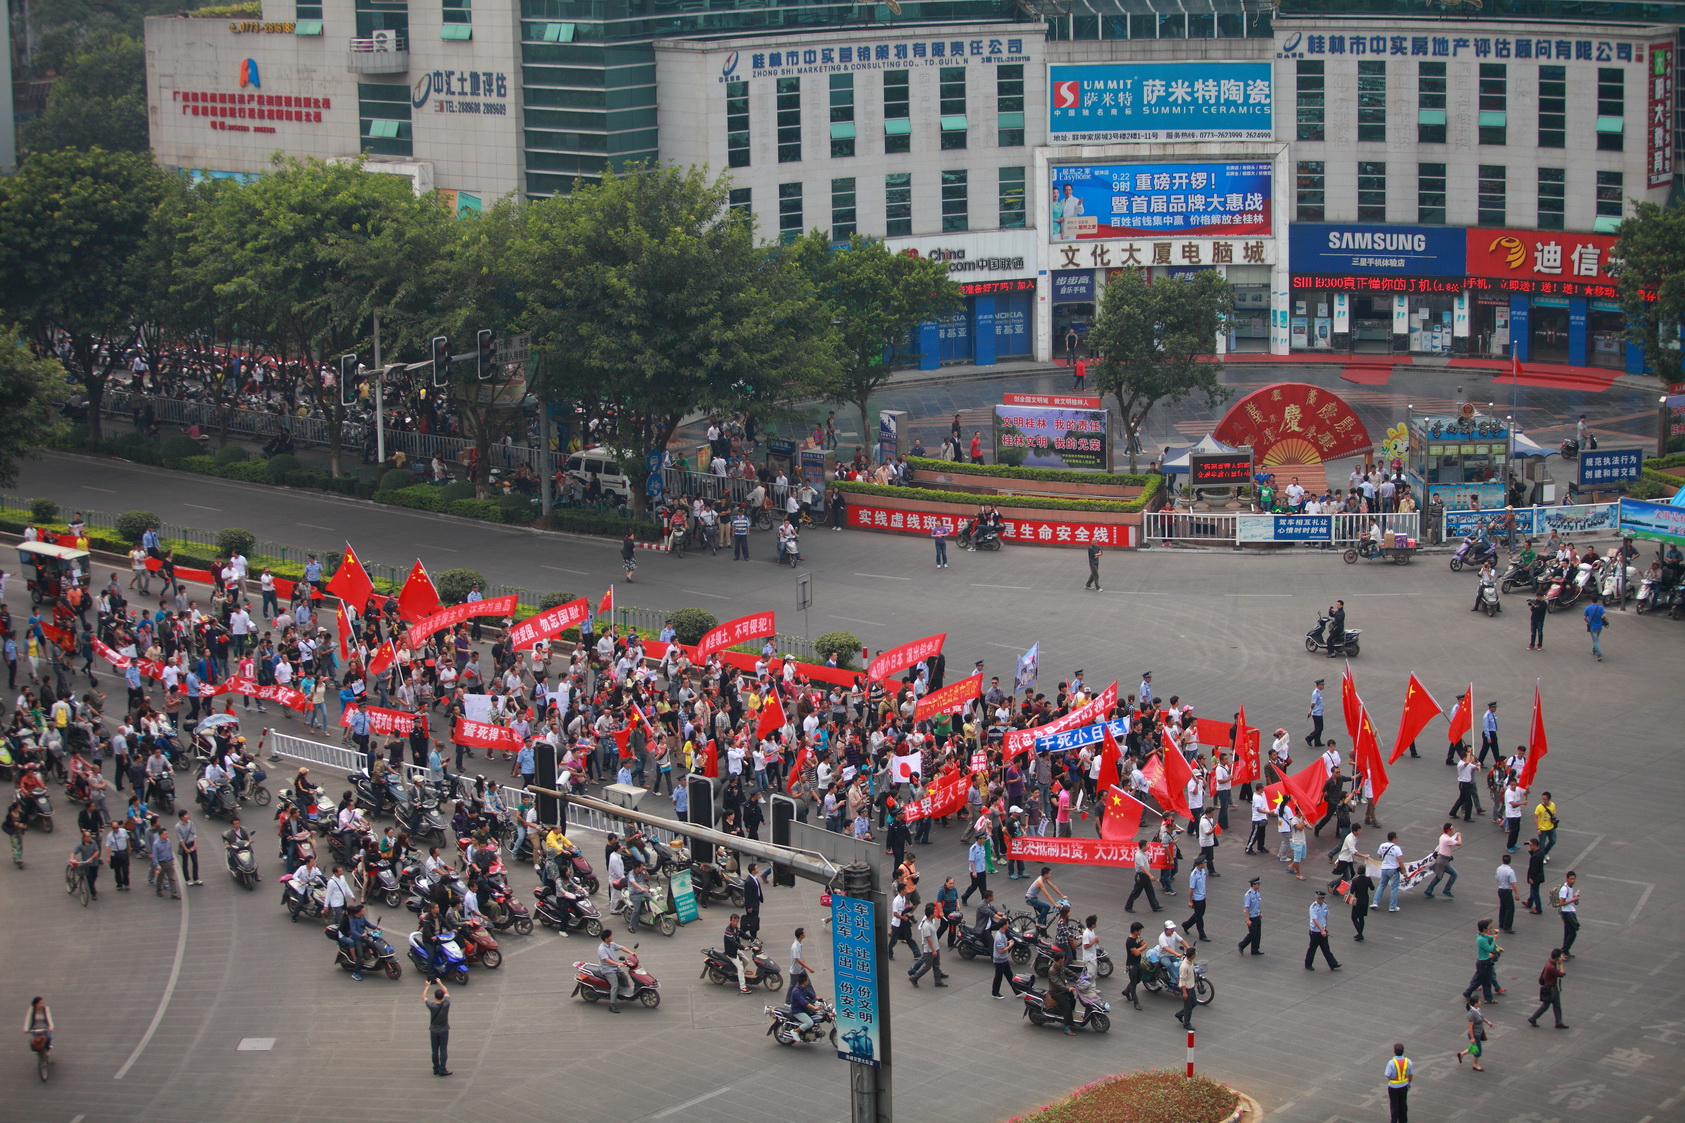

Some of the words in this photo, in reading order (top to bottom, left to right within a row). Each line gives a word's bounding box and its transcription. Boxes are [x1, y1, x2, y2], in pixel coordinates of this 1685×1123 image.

[752, 39, 1022, 69] 桂林市中实营销策划有限责任公司
[1307, 35, 1632, 62] 桂林市中实房地产评估顾问有限公司
[752, 70, 778, 78] ZHONG
[797, 65, 842, 74] MARKETING
[851, 61, 900, 70] CONSULTING
[433, 70, 507, 97] 中汇土地评估
[1143, 79, 1270, 104] 萨米特陶瓷
[1084, 92, 1132, 107] 萨米特
[1054, 108, 1132, 117] 中国驰名商标
[1143, 106, 1194, 114] SUMMIT
[1202, 106, 1271, 114] CERAMICS
[1060, 173, 1092, 182] Easyhome
[1135, 172, 1216, 191] 重磅开锣！
[1112, 181, 1130, 192] 9时
[1110, 193, 1264, 214] 暨首届品牌大惠战
[1111, 215, 1184, 227] 百姓省钱集中赢
[1190, 214, 1264, 225] 价格解放全桂林
[1328, 231, 1426, 251] SAMSUNG
[928, 248, 965, 261] China
[1060, 241, 1265, 268] 文化大厦电脑城
[1351, 257, 1405, 267] 三星手机体验店
[949, 261, 976, 272] com
[976, 257, 1024, 271] 中国联通
[1056, 276, 1090, 285] 步步高
[1173, 272, 1195, 280] 步步
[1017, 280, 1035, 290] 加入
[1059, 286, 1086, 295] 音乐手机
[1002, 416, 1048, 429] 文明桂林
[1054, 418, 1101, 432] 我的责任
[1279, 403, 1304, 433] 慶
[1002, 434, 1048, 448] 桂林文明
[1054, 437, 1101, 451] 我的光荣
[1585, 455, 1637, 466] 规范执法行为
[1585, 467, 1637, 479] 创建和谐交通
[1279, 518, 1328, 526] 驾车相互礼让
[836, 899, 852, 938] 人让车
[854, 903, 870, 943] 车让人
[838, 943, 855, 1020] 让出一份安全
[855, 947, 873, 1024] 让出一份文明
